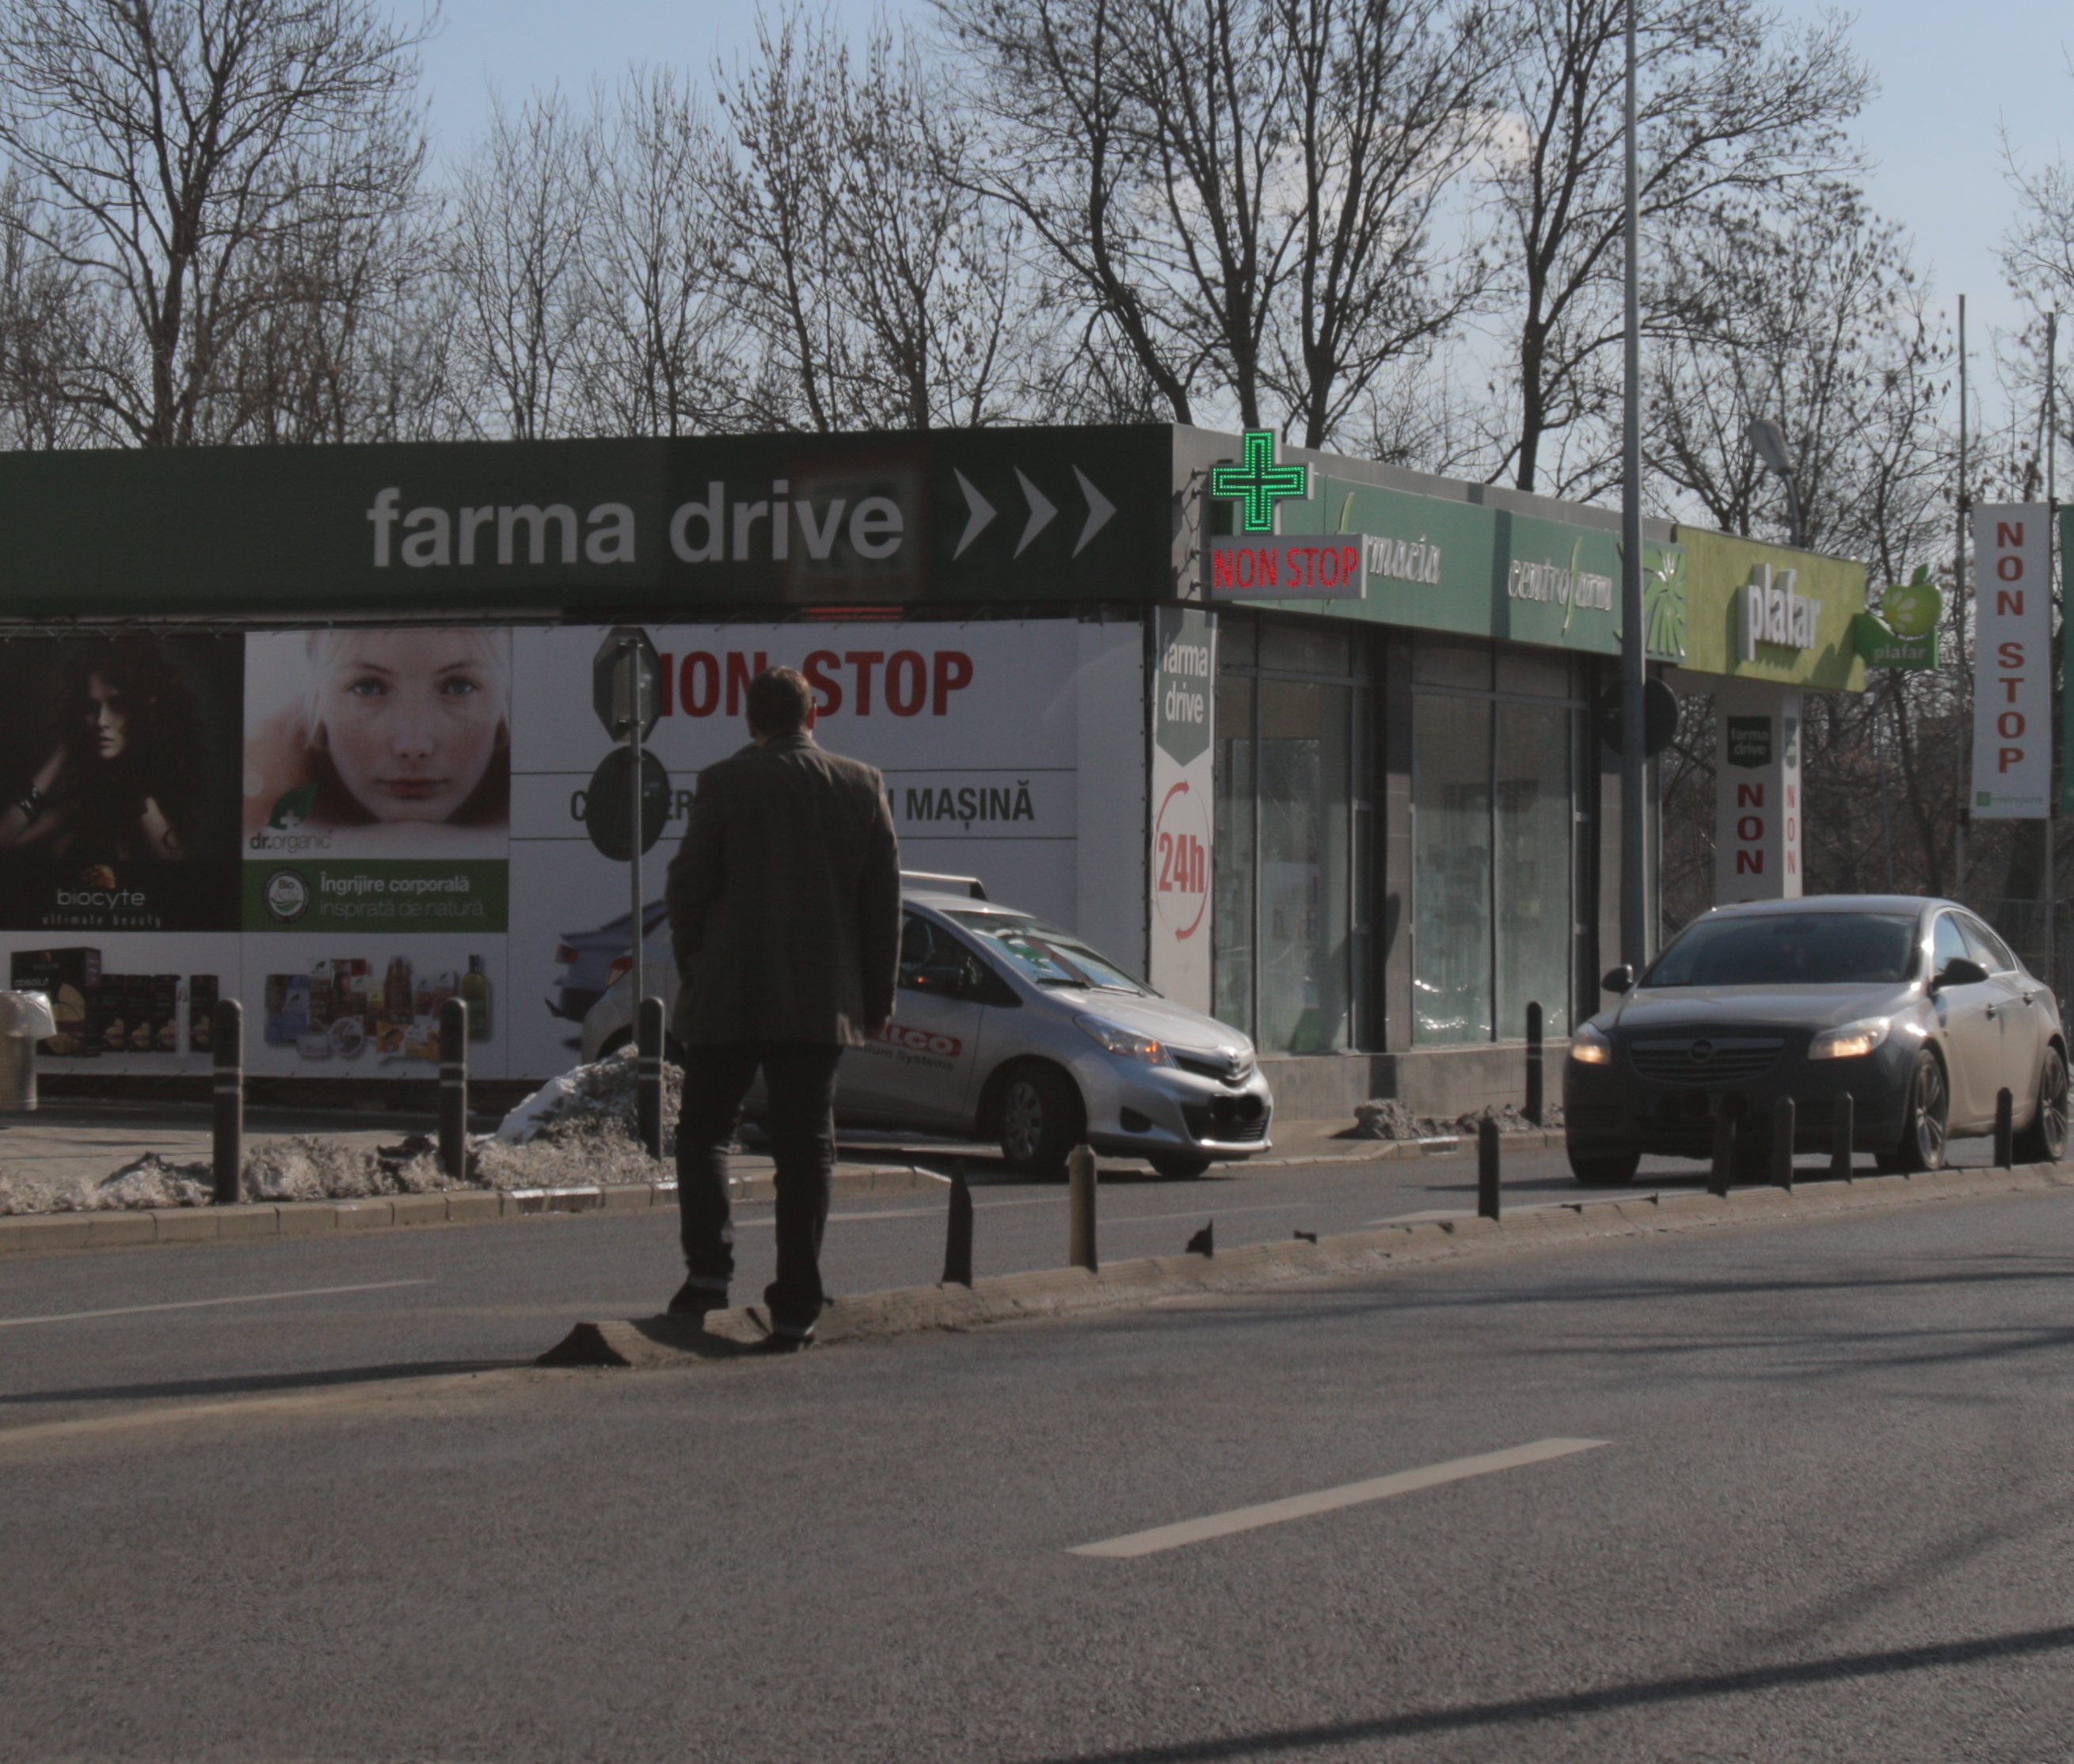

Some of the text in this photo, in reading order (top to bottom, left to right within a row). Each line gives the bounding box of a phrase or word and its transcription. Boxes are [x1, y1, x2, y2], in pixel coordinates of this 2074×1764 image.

[367, 478, 904, 568] farma drive
[1213, 546, 1360, 589] NON STOP
[1368, 534, 1441, 585] macia
[1746, 562, 1821, 661] plafar
[1163, 633, 1208, 677] farma
[1874, 643, 1926, 663] plafar
[1997, 522, 2026, 774] NON STOP
[802, 650, 973, 717] STOP
[1166, 680, 1204, 724] drive
[1730, 726, 1769, 741] farma
[1733, 742, 1767, 756] drive
[906, 781, 1035, 831] MAȘINĂ
[1737, 783, 1764, 874] NON
[320, 871, 385, 895] Îngrijire
[389, 874, 470, 895] corporală
[1159, 831, 1204, 894] 24h
[57, 888, 146, 909] biocyte
[320, 899, 484, 920] inspirată de natură
[43, 914, 162, 928] ultimate beauty
[896, 1050, 954, 1071] Systems
